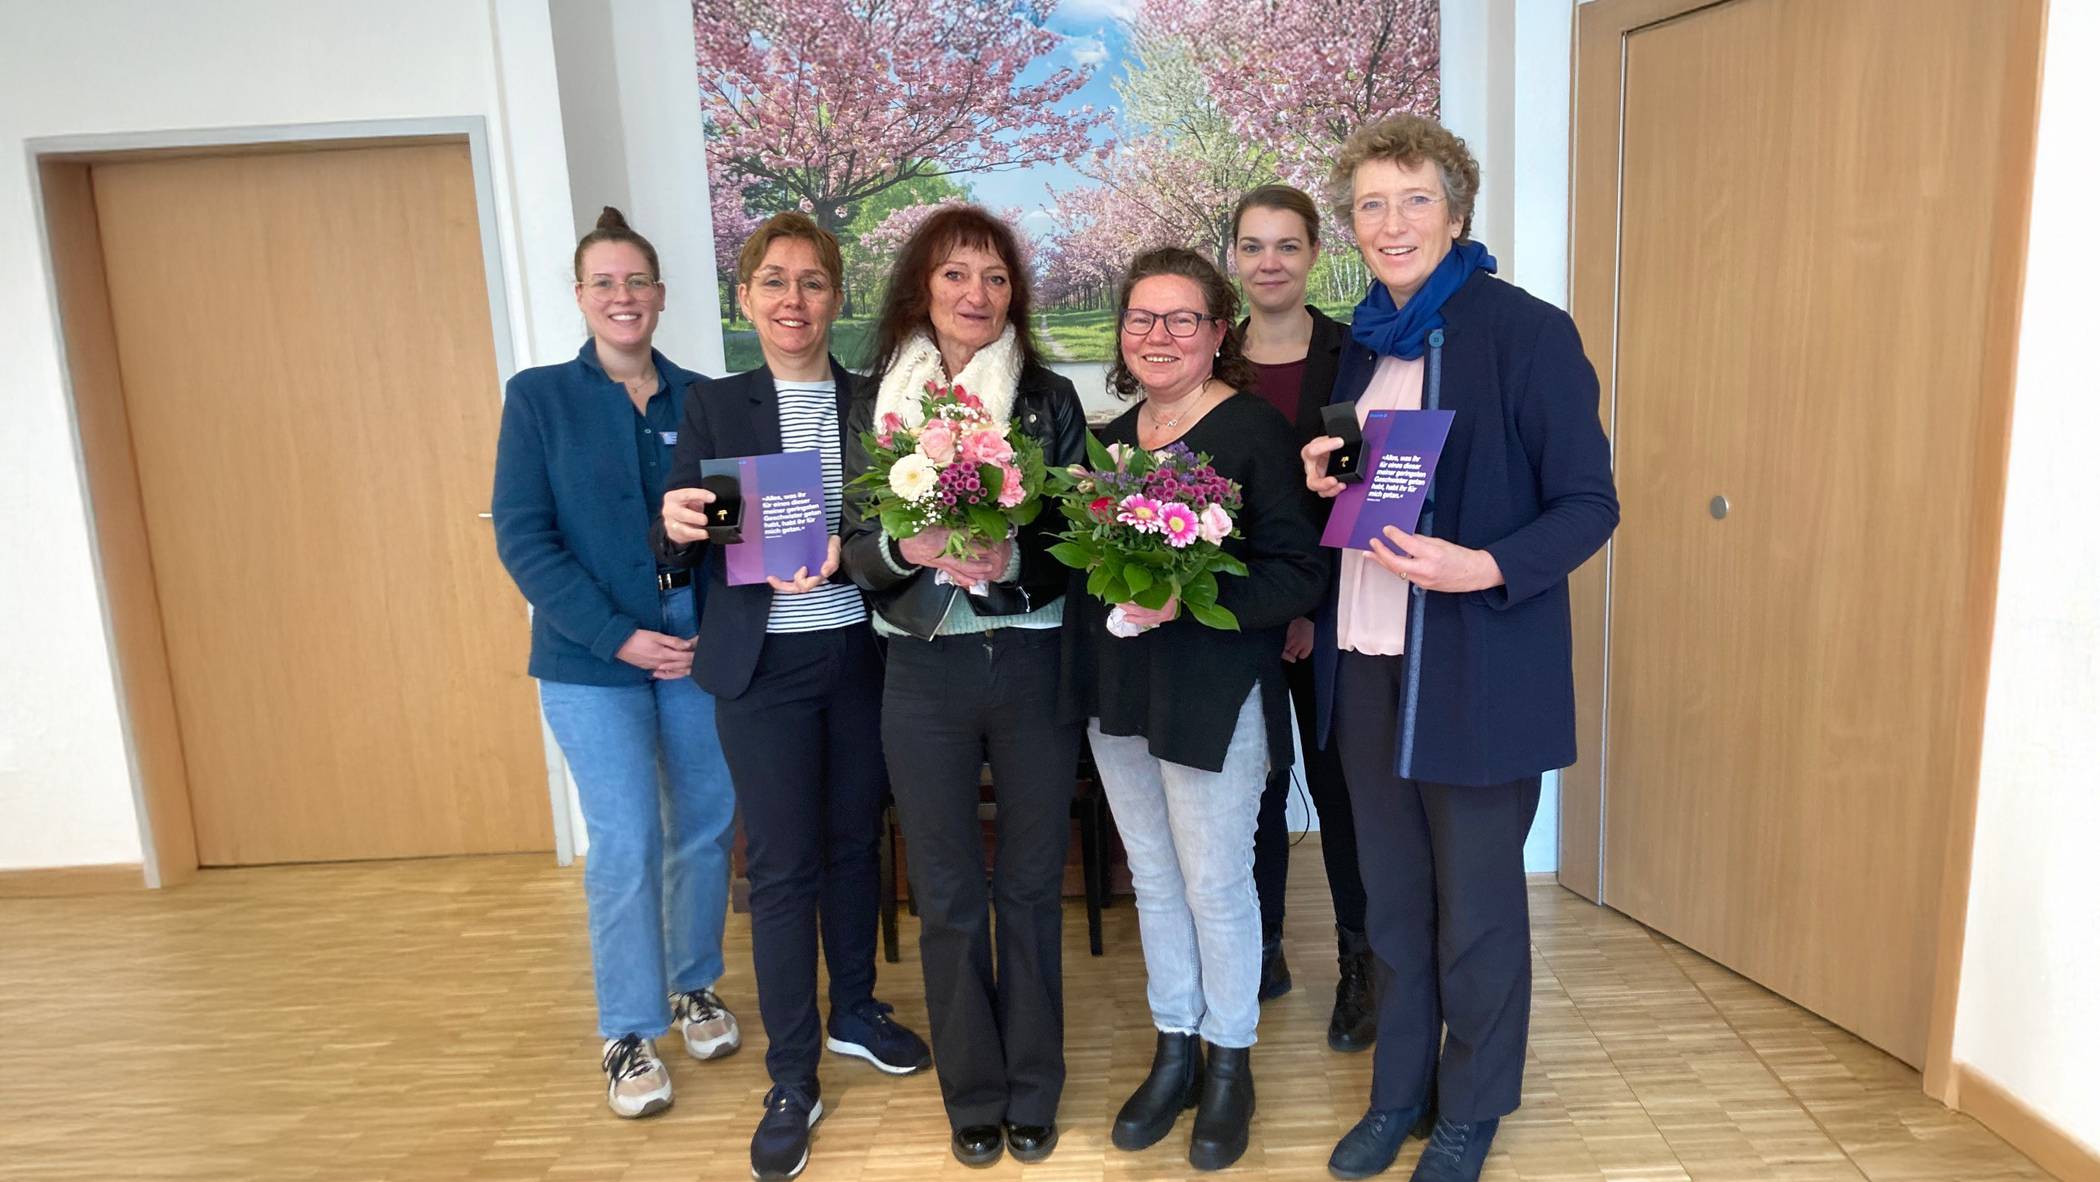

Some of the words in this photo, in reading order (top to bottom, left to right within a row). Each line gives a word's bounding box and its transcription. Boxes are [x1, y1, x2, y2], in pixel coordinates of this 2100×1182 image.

[1403, 462, 1422, 470] dieser
[1395, 470, 1427, 478] geringsten
[1373, 475, 1408, 484] Geschwister
[1407, 478, 1426, 486] getan
[1385, 483, 1399, 491] habt
[786, 503, 819, 513] geringsten
[763, 513, 802, 521] Geschwister
[803, 510, 822, 518] getan
